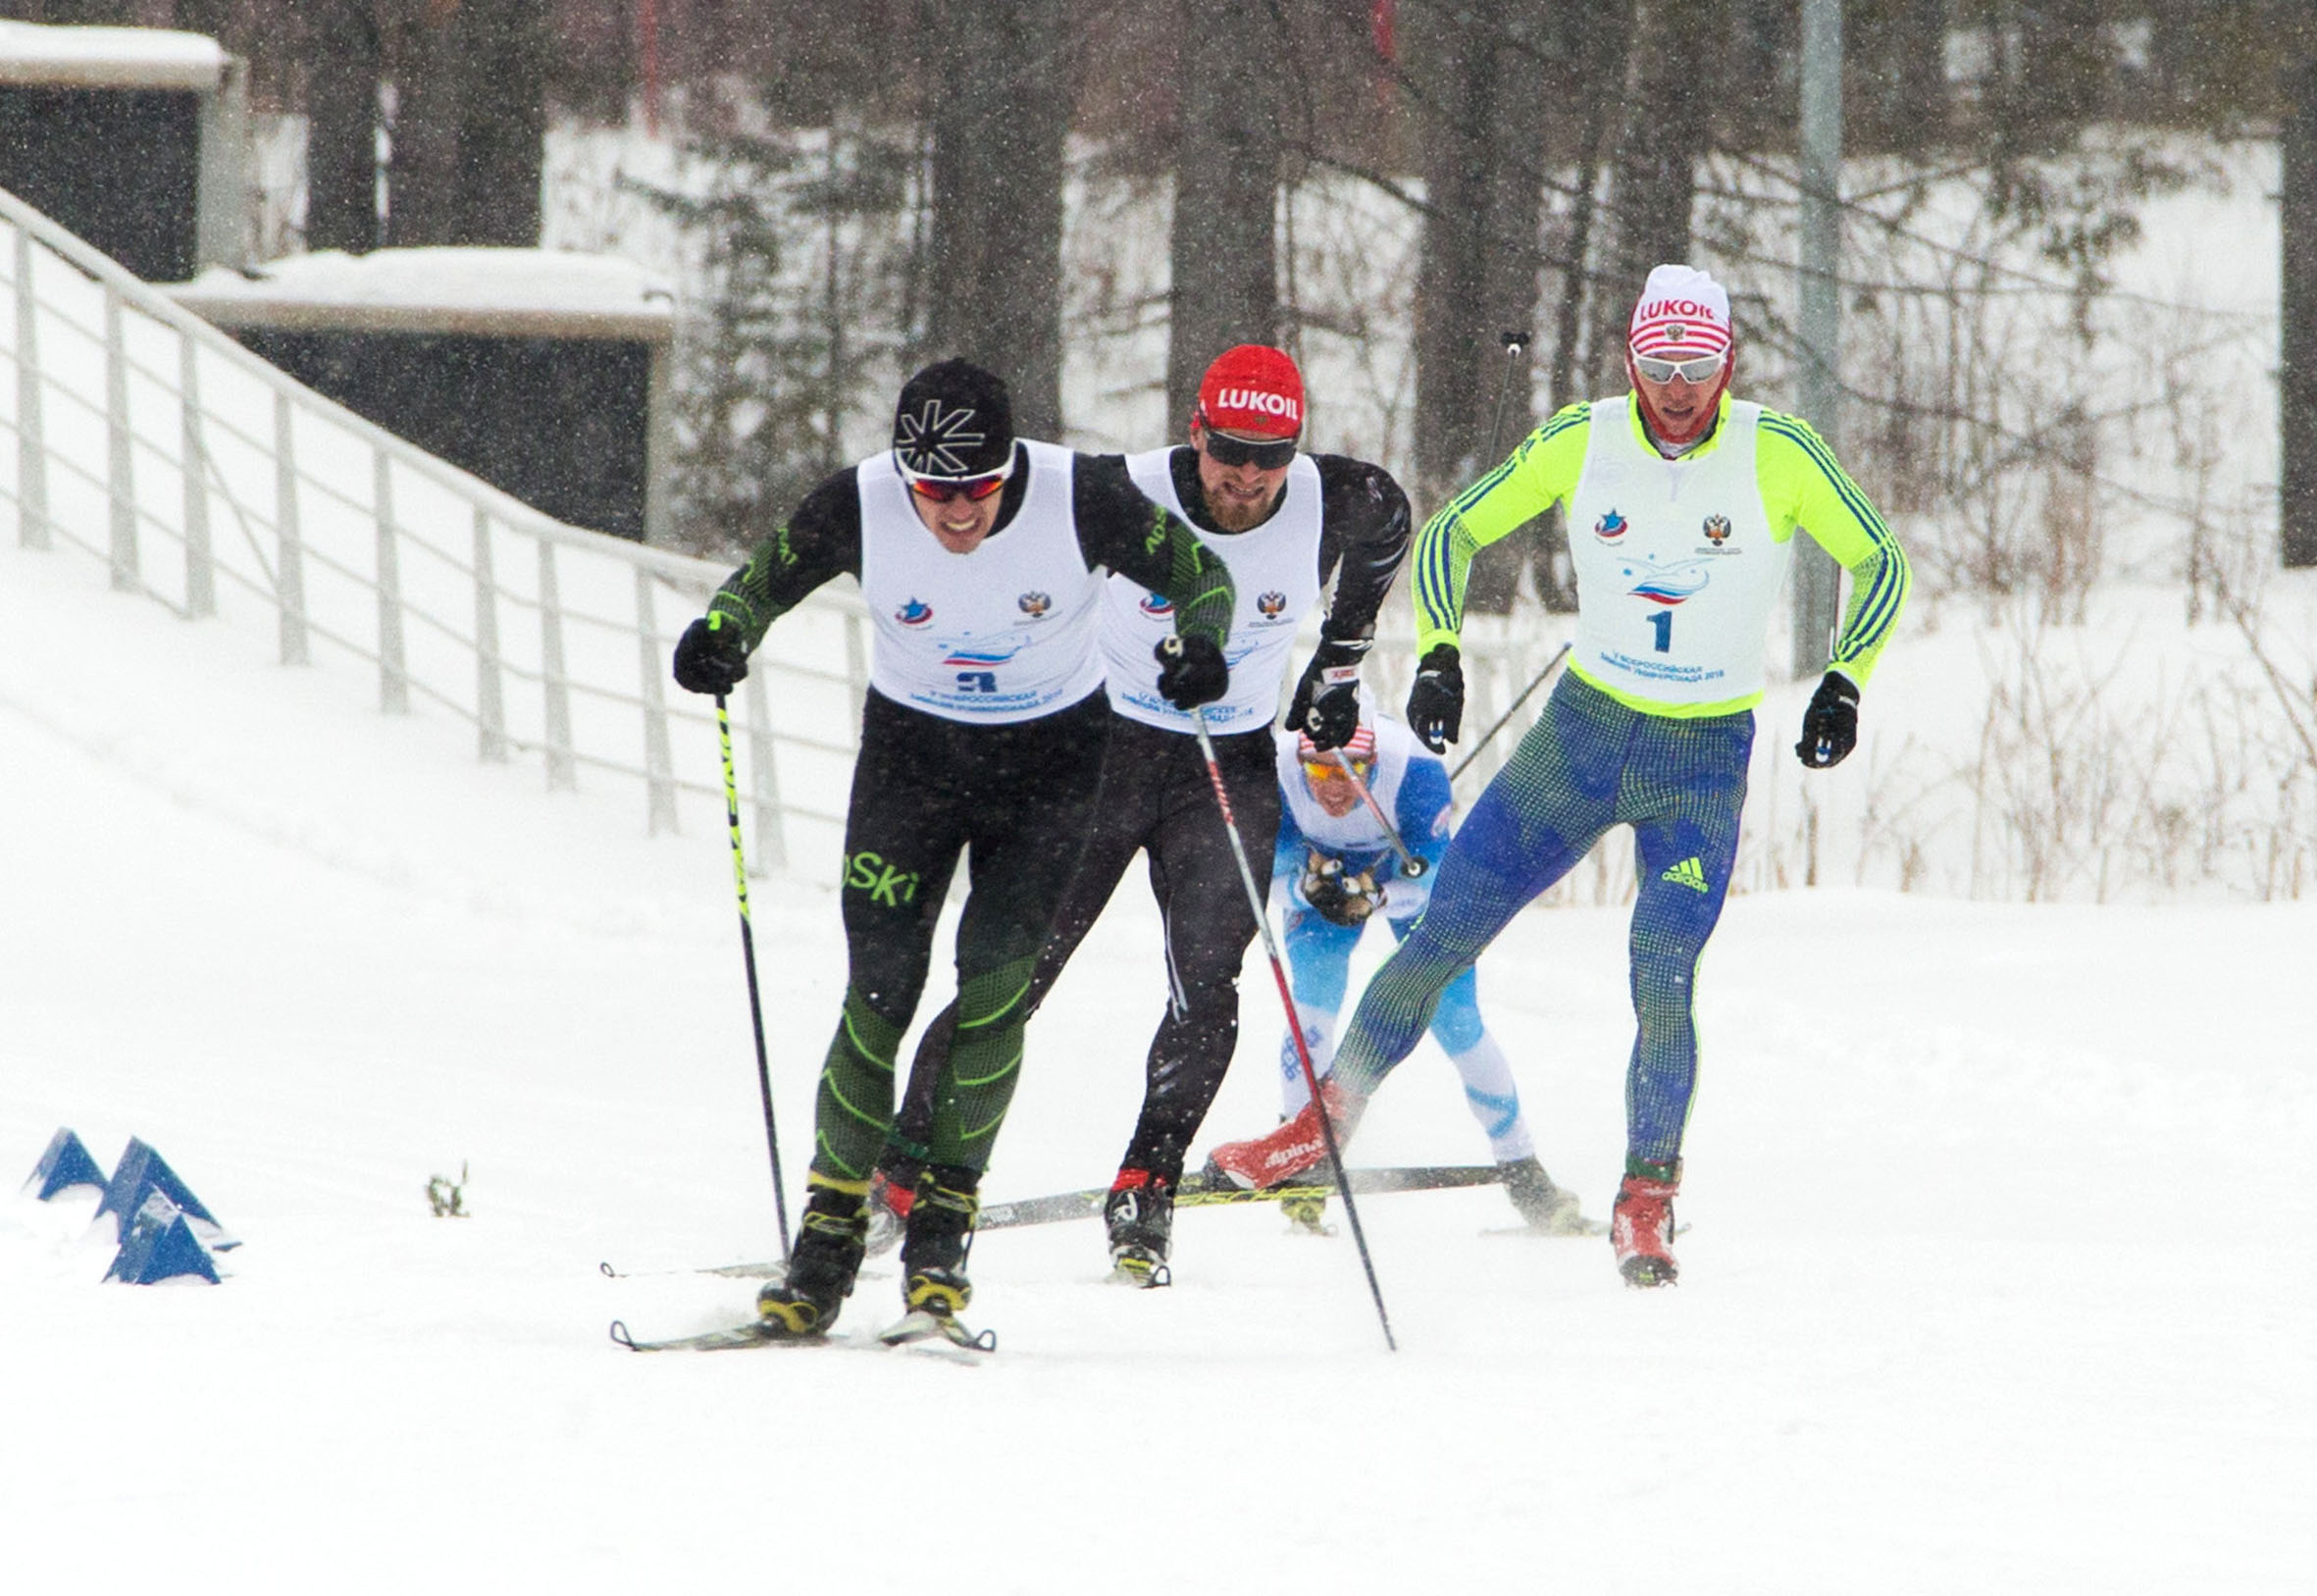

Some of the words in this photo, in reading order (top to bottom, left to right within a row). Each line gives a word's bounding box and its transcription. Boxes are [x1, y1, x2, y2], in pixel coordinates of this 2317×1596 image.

[1640, 299, 1714, 323] LUKOIL
[1218, 388, 1298, 421] LUKOIL
[1646, 610, 1673, 653] 1
[1661, 871, 1709, 894] adidas
